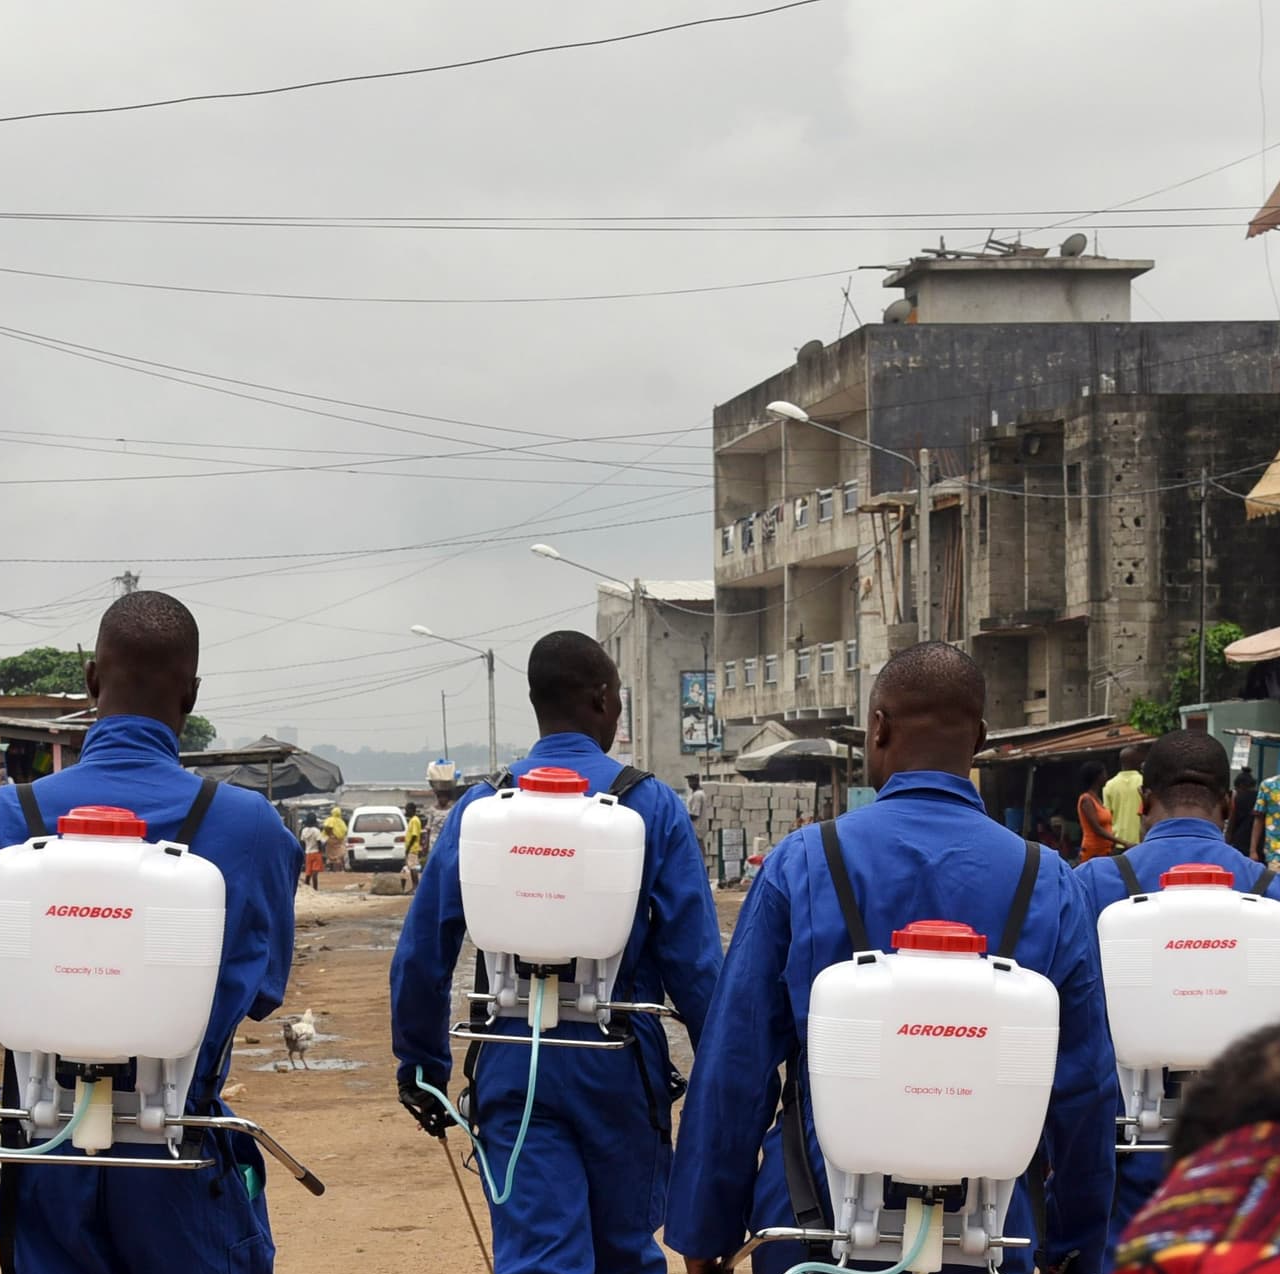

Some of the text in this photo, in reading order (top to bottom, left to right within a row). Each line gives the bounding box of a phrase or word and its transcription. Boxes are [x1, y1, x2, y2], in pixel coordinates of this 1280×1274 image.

[510, 845, 576, 857] AGROBOSS
[45, 905, 133, 919] AGROBOSS
[1164, 939, 1238, 950] AGROBOSS
[54, 965, 92, 976] Capacity
[94, 967, 104, 975] 15
[897, 1024, 988, 1038] AGROBOSS
[904, 1085, 973, 1096] Capacity 15 Liter
